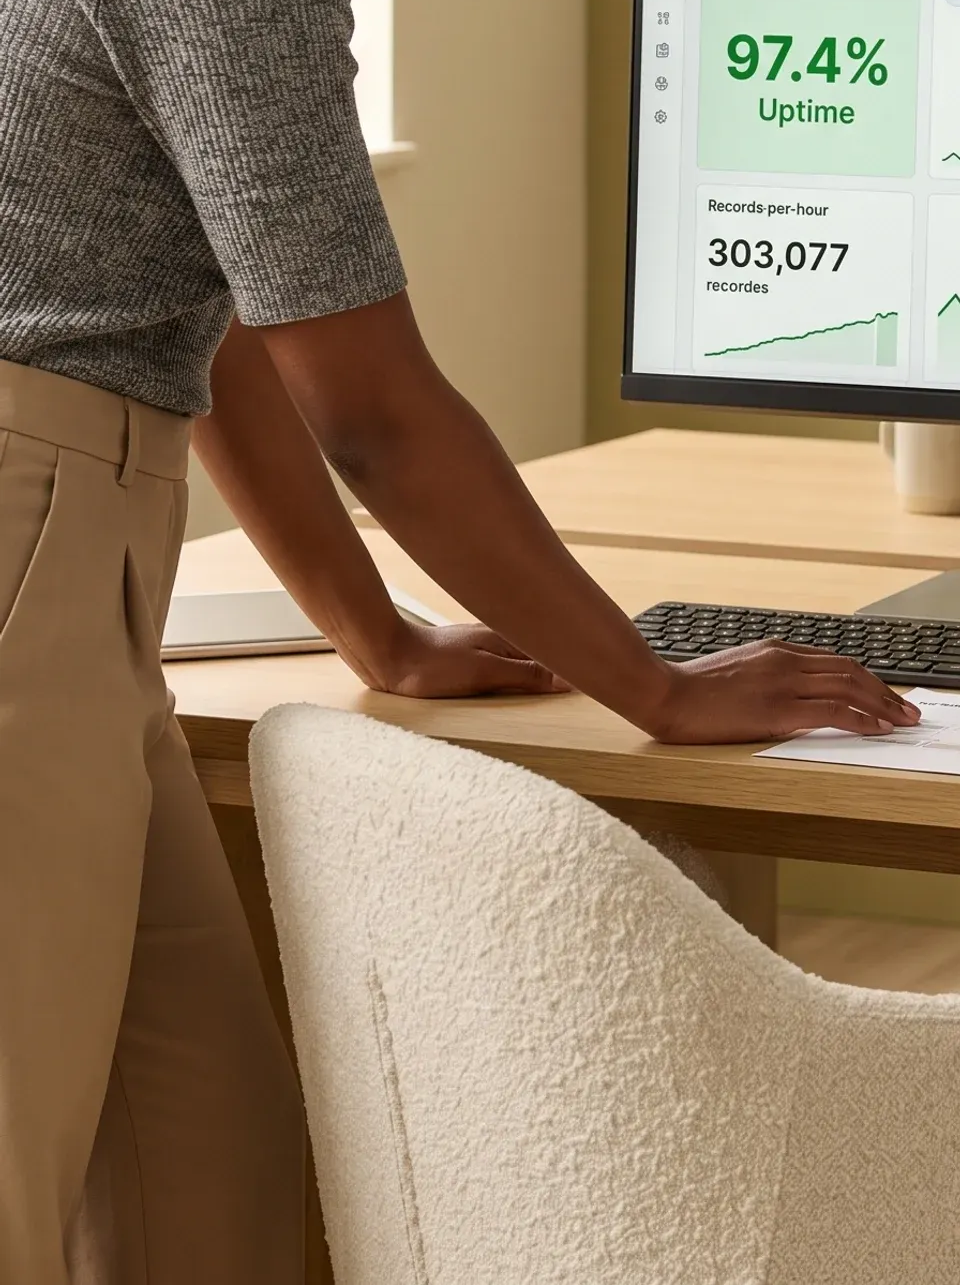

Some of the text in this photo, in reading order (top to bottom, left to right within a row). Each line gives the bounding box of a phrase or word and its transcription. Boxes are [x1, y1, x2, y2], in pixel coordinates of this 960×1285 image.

[726, 33, 889, 87] 97.4%
[758, 97, 856, 129] Uptime
[708, 237, 850, 277] 303,077
[706, 279, 770, 295] recordes
